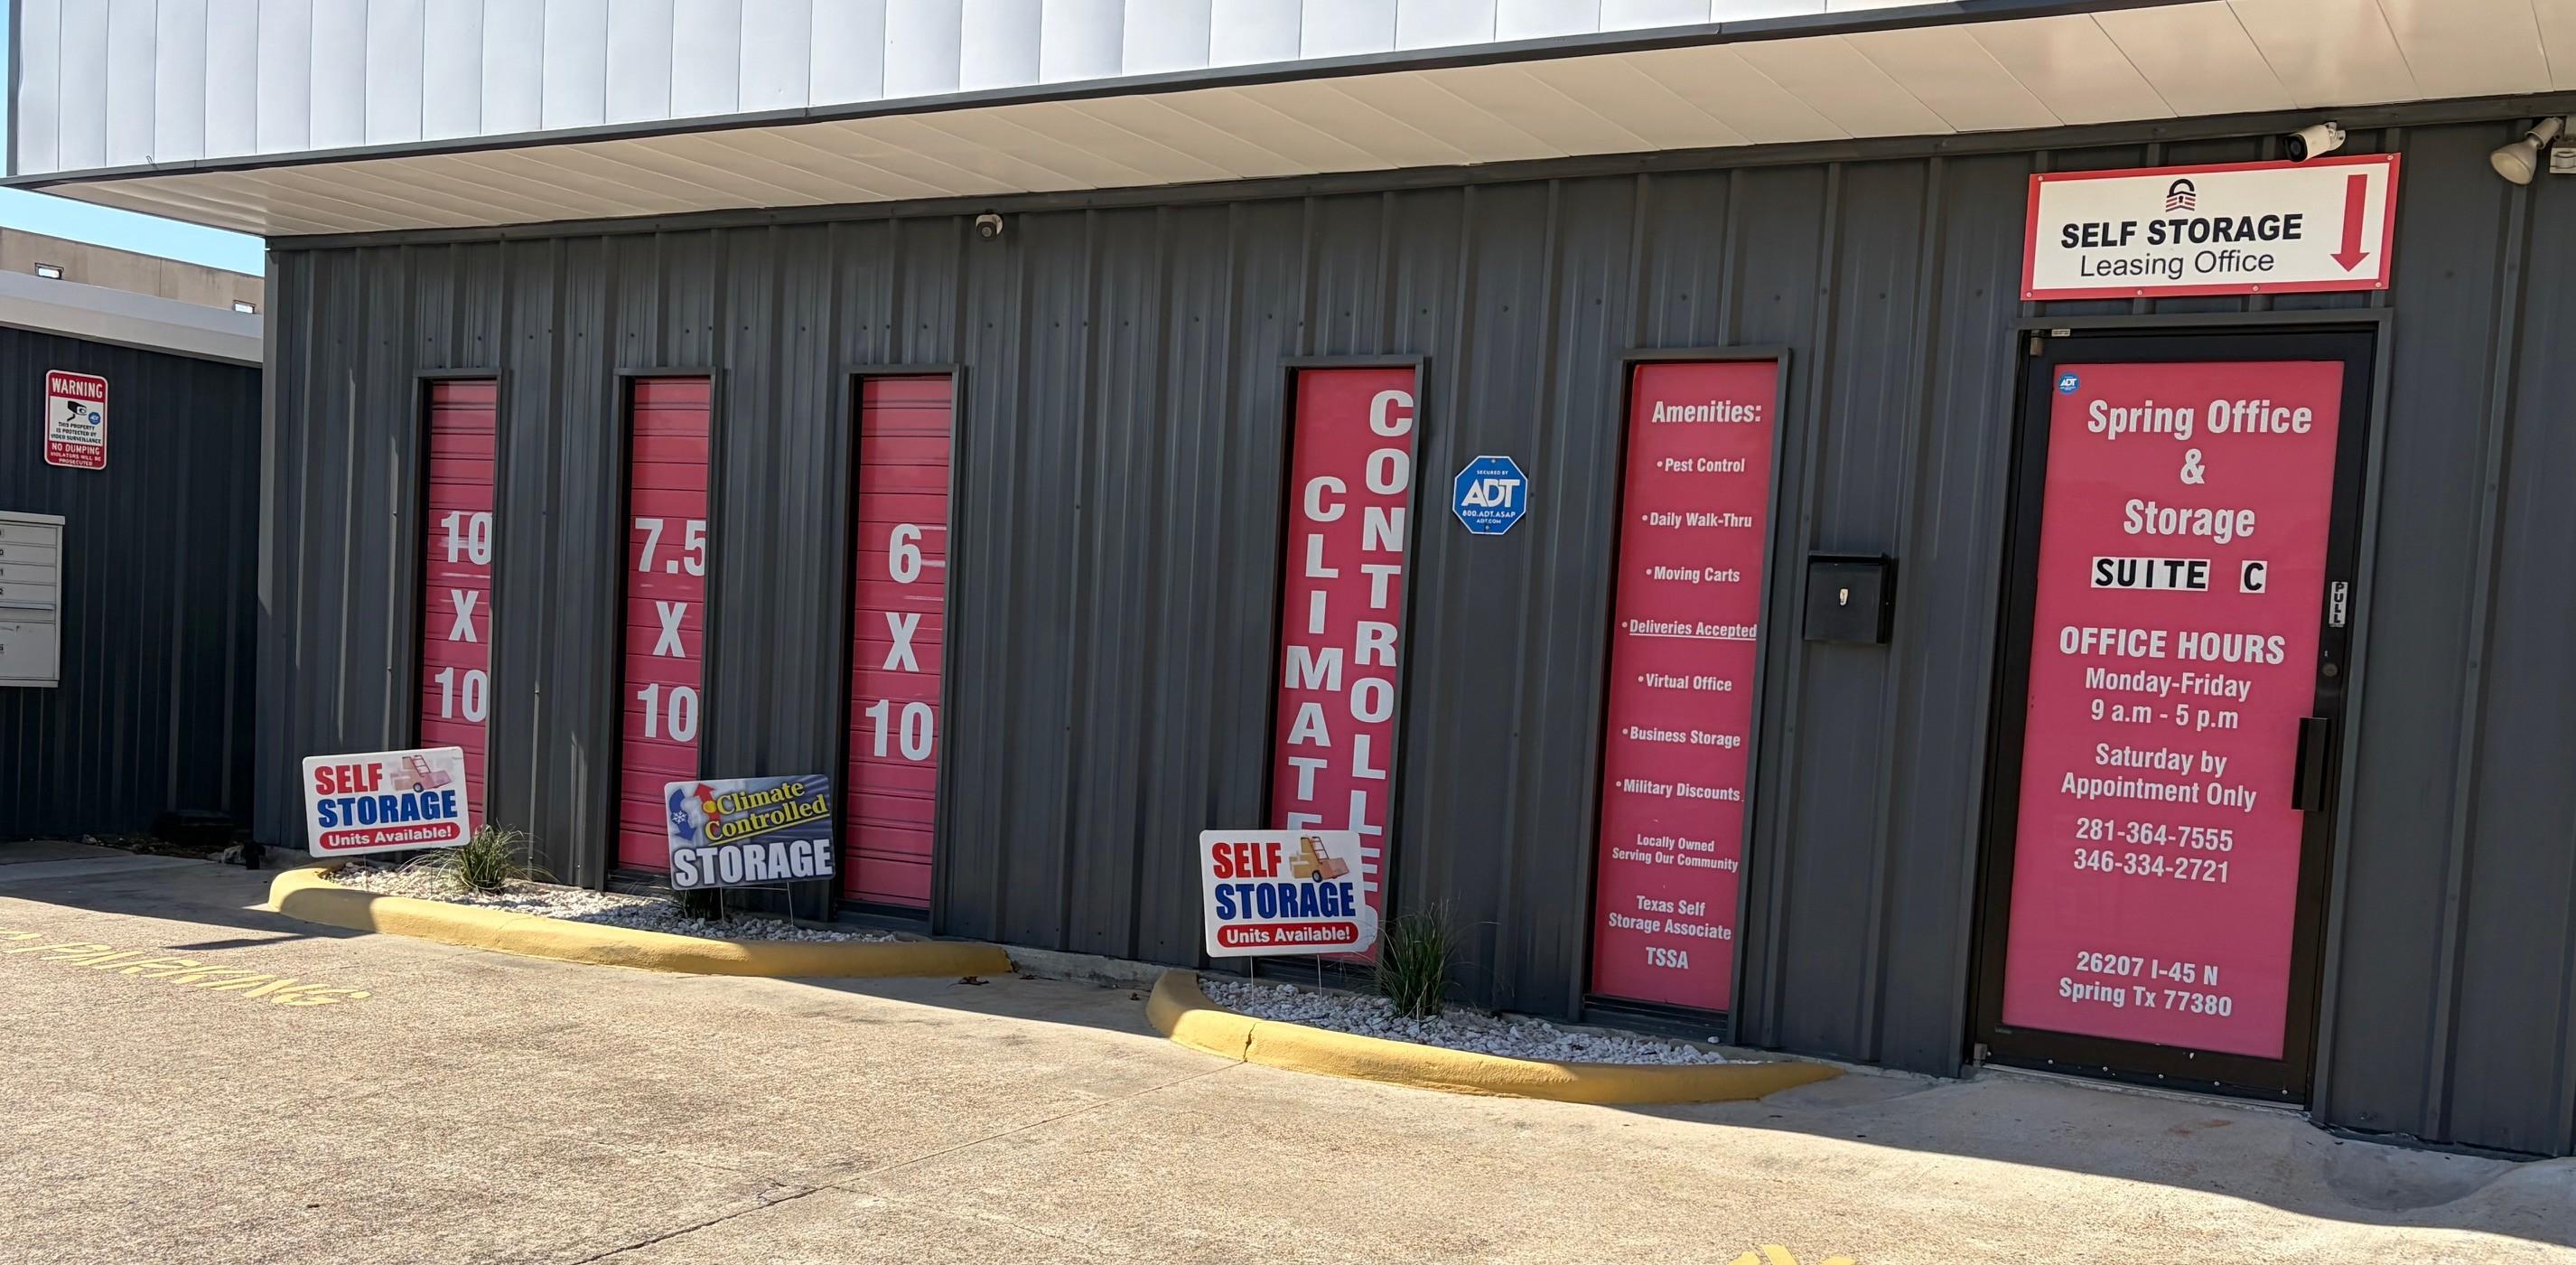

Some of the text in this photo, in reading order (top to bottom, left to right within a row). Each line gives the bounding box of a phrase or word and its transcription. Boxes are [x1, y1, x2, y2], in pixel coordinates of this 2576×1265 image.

[2061, 213, 2303, 248] SELF STORAGE
[2080, 249, 2274, 280] Leasing Office
[51, 378, 103, 398] WARNING
[2060, 378, 2077, 387] ADT
[1652, 400, 1761, 423] Amenities:
[2087, 399, 2312, 440] Spring Office
[51, 442, 100, 455] NO DUMPING
[1666, 457, 1745, 473] Pest Control
[2179, 448, 2205, 484] &
[1461, 478, 1520, 508] ADT
[1650, 511, 1752, 529] Daily Walk-Thru
[2123, 499, 2255, 544] Storage
[441, 511, 492, 566] 10
[635, 518, 706, 576] 7.5
[889, 523, 922, 584] 6
[1654, 566, 1741, 584] Moving Carts
[2095, 558, 2264, 592] SUITE C
[448, 589, 480, 642] X
[2334, 583, 2345, 623] PULL
[652, 600, 688, 658] X
[882, 611, 921, 672] X
[1629, 619, 1758, 639] Deliveries Accepted
[2059, 626, 2286, 665] OFFICE HOURS
[434, 667, 488, 723] 10
[1647, 673, 1732, 692] Virtual Office
[2085, 667, 2251, 702] Monday-Friday
[638, 683, 699, 743] 10
[865, 698, 934, 761] 10
[2091, 698, 2105, 720] 9
[2112, 704, 2152, 724] a.m
[2176, 704, 2189, 726] 5
[2197, 709, 2239, 732] p.m
[1630, 726, 1741, 749] Business Storage
[2095, 743, 2227, 778] Saturday by
[314, 763, 383, 795] SELF
[1624, 778, 1741, 801] Military Discounts
[2061, 772, 2257, 812] Appointment Only
[317, 790, 458, 829] STORAGE
[716, 782, 806, 815] Climate
[705, 793, 828, 841] Controlled
[2076, 817, 2234, 852] 281-364-7555
[328, 826, 452, 847] Units Available!
[1637, 834, 1714, 853] Locally Owned
[674, 839, 834, 887] STORAGE
[1211, 842, 1282, 879] SELF
[1612, 847, 1739, 874] Serving Our Community
[2074, 848, 2229, 883] 346-334-2721
[1215, 882, 1356, 920] STORAGE
[1637, 895, 1706, 917] Texas Self
[1227, 926, 1351, 943] Units Available!
[1609, 913, 1732, 941] Storage Associate
[3, 942, 372, 1006] PARKING
[1646, 946, 1689, 970] TSSA
[2077, 951, 2218, 986] 26207 I-45 N
[2059, 977, 2233, 1017] Spring Tx 77380
